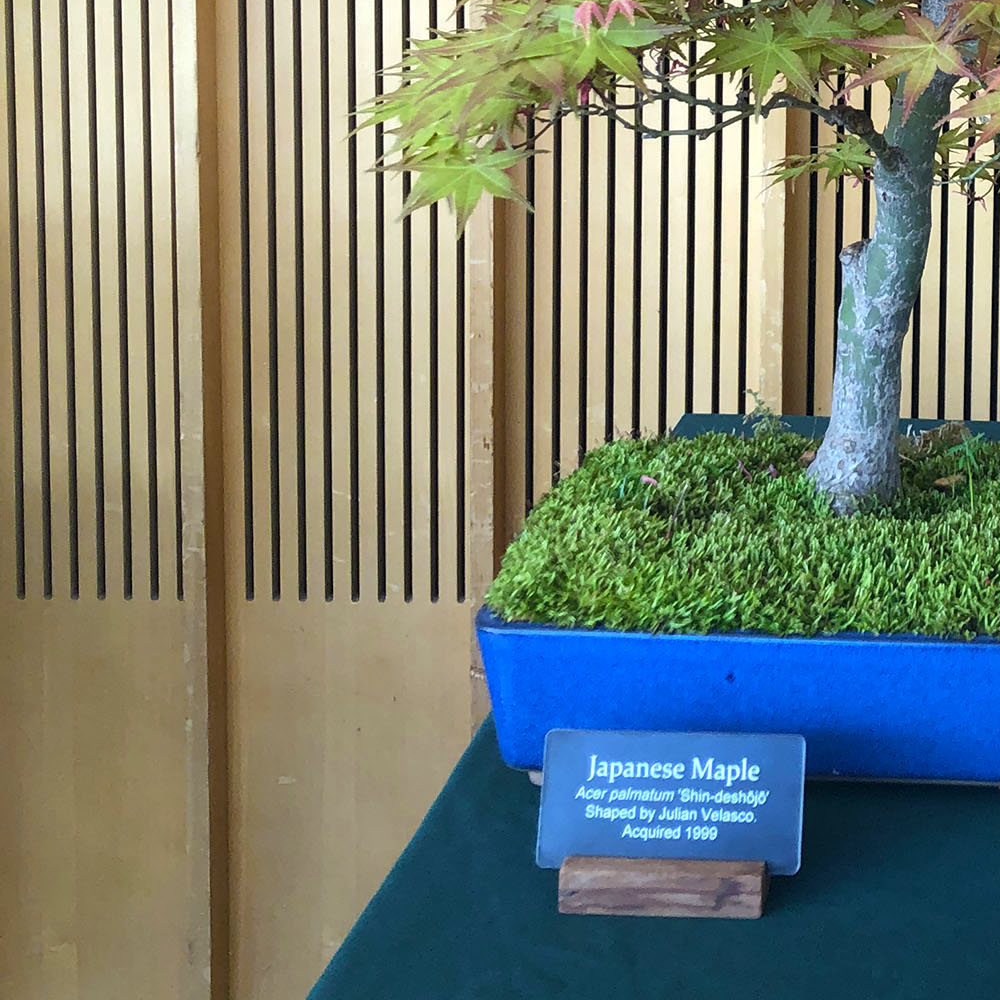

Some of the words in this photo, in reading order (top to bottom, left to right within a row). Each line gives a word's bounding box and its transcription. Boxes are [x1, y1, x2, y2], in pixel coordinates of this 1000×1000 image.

[587, 754, 685, 783] Japanese
[691, 757, 761, 786] Maple
[575, 786, 606, 801] Acer
[609, 787, 675, 803] palmatum
[585, 804, 636, 821] Shaped
[640, 806, 656, 823] by
[658, 806, 697, 821] Julian
[621, 824, 681, 841] Acquired
[685, 826, 718, 841] 1999
